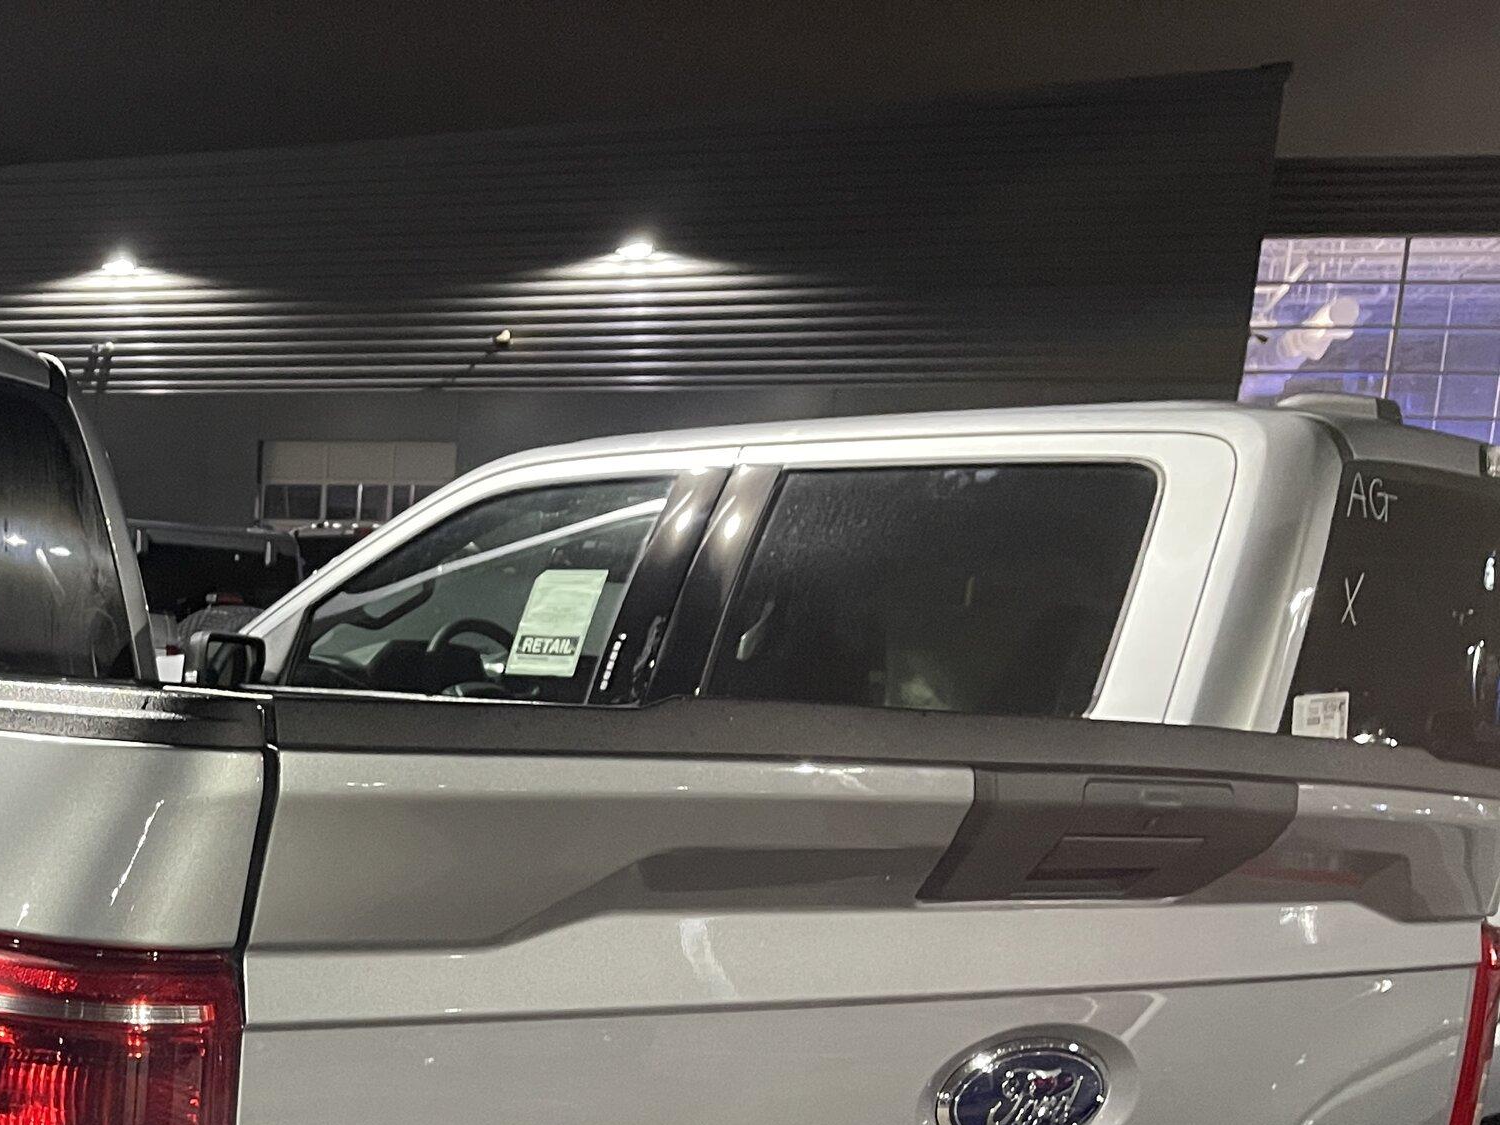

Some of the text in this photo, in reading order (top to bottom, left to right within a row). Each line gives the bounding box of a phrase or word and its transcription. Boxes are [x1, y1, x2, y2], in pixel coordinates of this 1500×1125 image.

[1346, 471, 1398, 523] AG
[1340, 572, 1365, 626] X
[521, 637, 572, 654] RETAIL
